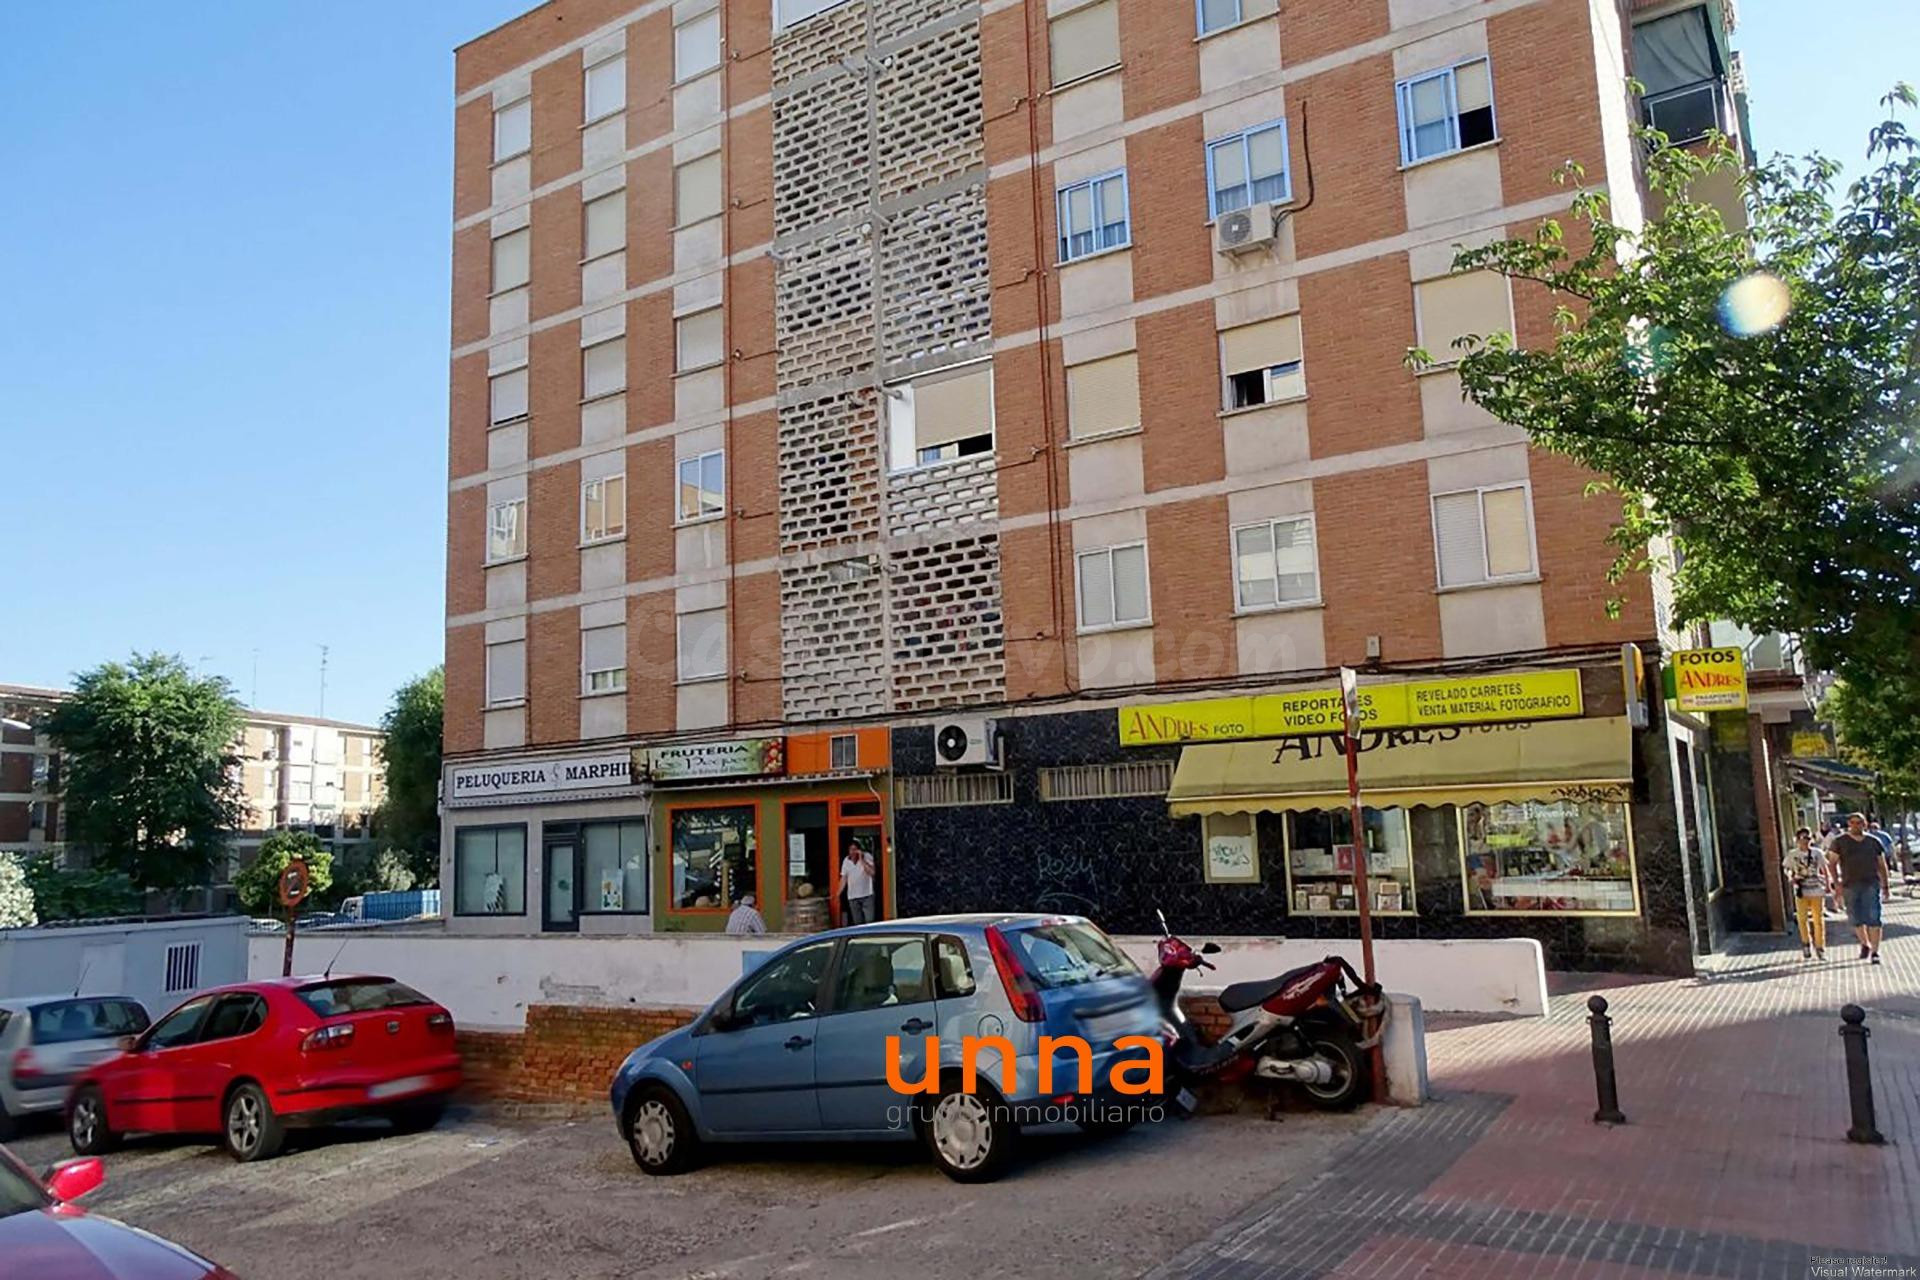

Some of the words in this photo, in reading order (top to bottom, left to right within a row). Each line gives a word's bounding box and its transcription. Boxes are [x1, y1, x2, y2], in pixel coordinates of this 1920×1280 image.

[1680, 651, 1735, 665] FOTOS
[1681, 670, 1742, 688] ANDRES
[1416, 688, 1466, 702] REVELADO
[1470, 683, 1523, 698] CARRETES
[1282, 695, 1373, 712] REPORTAES
[1417, 704, 1447, 717] VENTA
[1450, 700, 1497, 714] MATERIAL
[1500, 694, 1571, 711] FOTOGRAFICO
[1129, 711, 1208, 741] ANDRES
[1213, 723, 1245, 736] FOTO
[1284, 713, 1326, 727] VIDEO
[661, 745, 749, 759] FRUTERIA
[456, 770, 546, 790] PELUQUERIA
[565, 762, 632, 782] MARPHI
